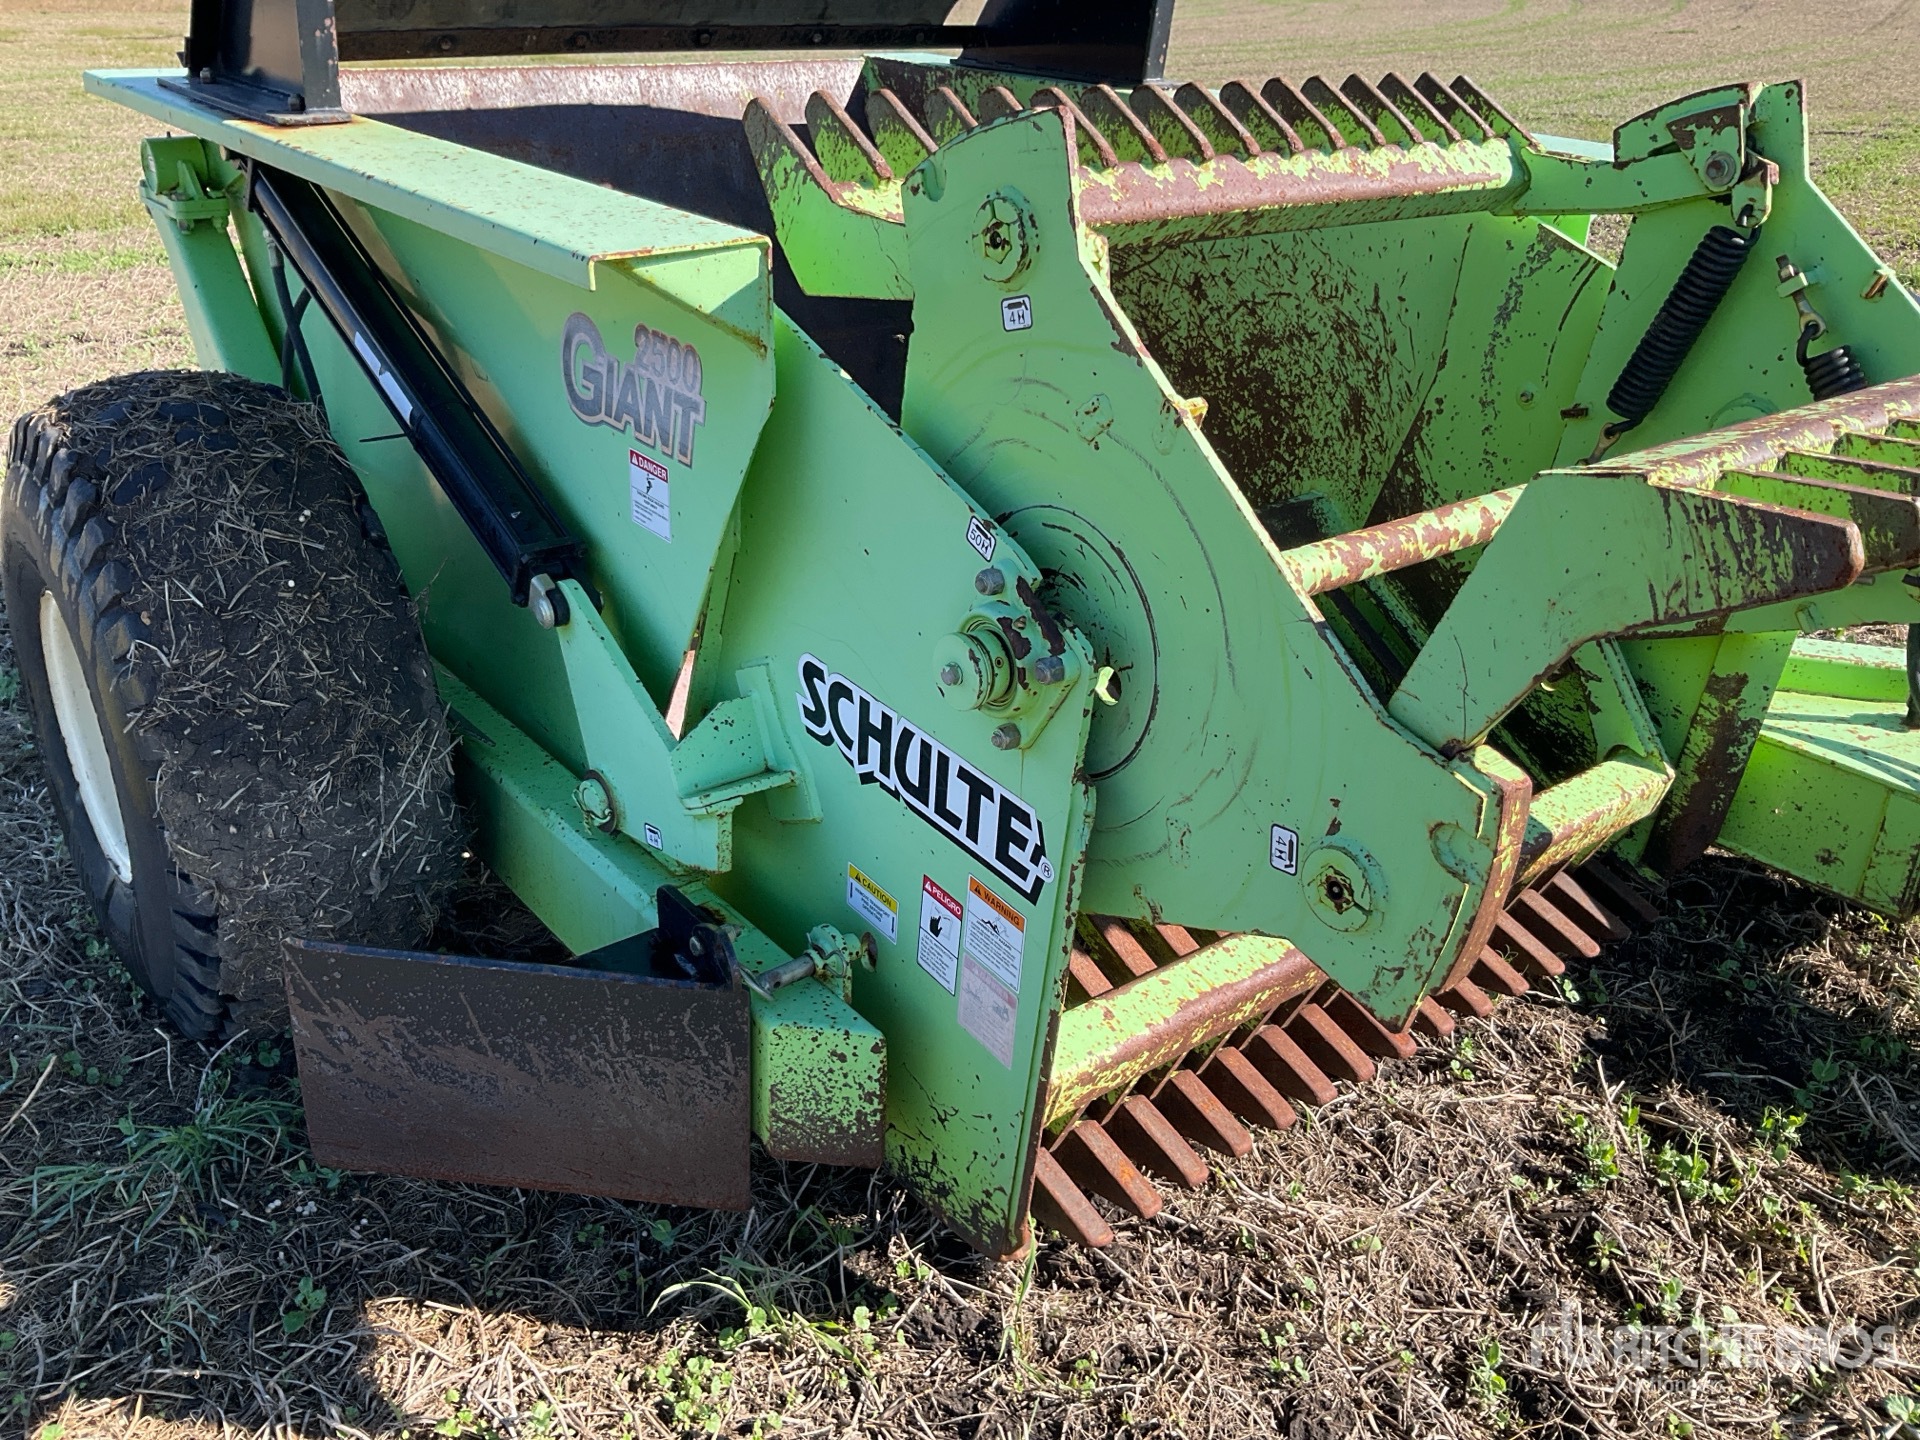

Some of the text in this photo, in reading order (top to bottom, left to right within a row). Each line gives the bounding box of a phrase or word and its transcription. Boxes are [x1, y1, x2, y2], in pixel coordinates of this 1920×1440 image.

[635, 323, 702, 394] 2500
[562, 312, 705, 468] GIANT
[638, 457, 668, 481] DANGER
[799, 655, 1042, 895] SCHULTE
[862, 878, 892, 908] CAUTION
[932, 886, 962, 916] PELIGRO
[984, 891, 1020, 926] WARNING
